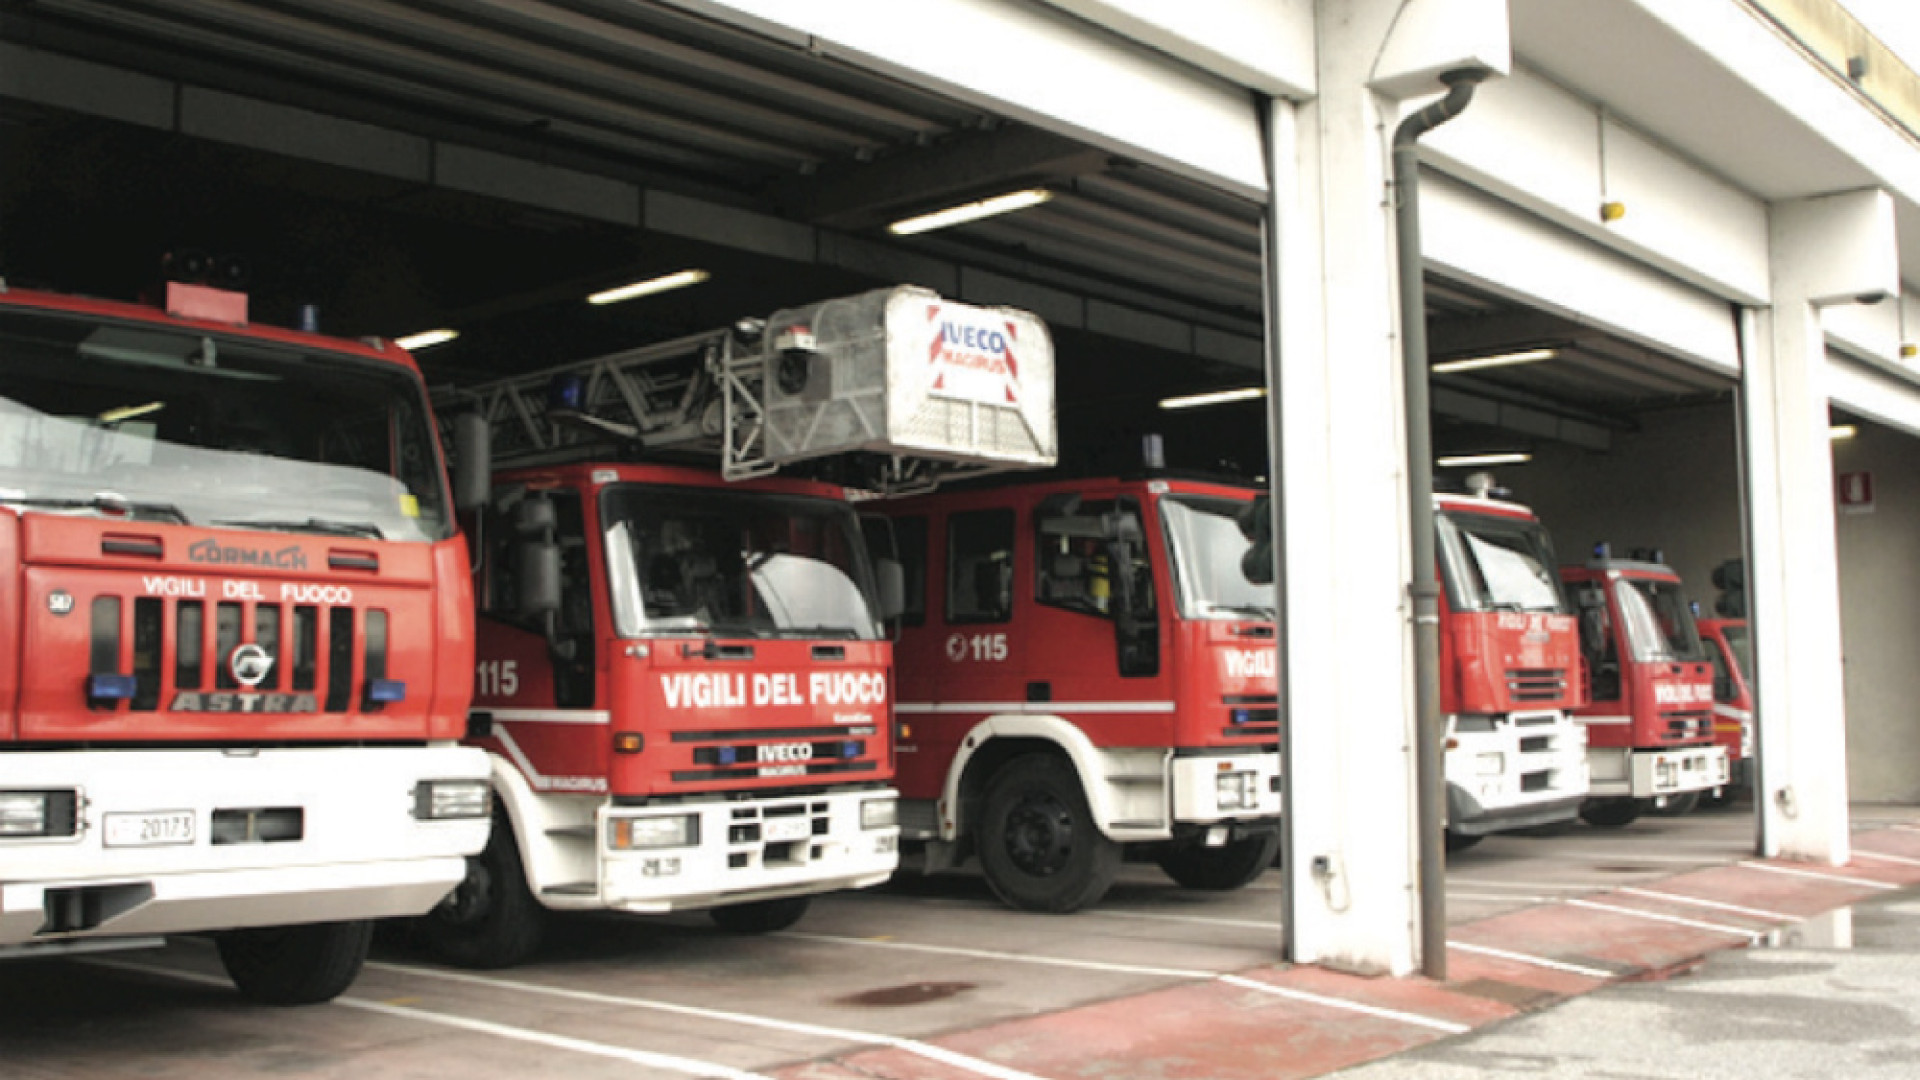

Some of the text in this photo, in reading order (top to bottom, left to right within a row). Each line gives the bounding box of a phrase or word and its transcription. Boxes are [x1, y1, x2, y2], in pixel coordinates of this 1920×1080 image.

[940, 320, 1006, 354] IVECO
[188, 537, 308, 570] CORMACH
[143, 576, 353, 604] VIGILI DEL FUOCO
[970, 633, 1008, 662] 115
[477, 660, 519, 697] 115
[661, 672, 887, 709] VIGILI DEL FUOCO
[170, 690, 317, 713] ASTRA
[757, 742, 813, 763] IVECO
